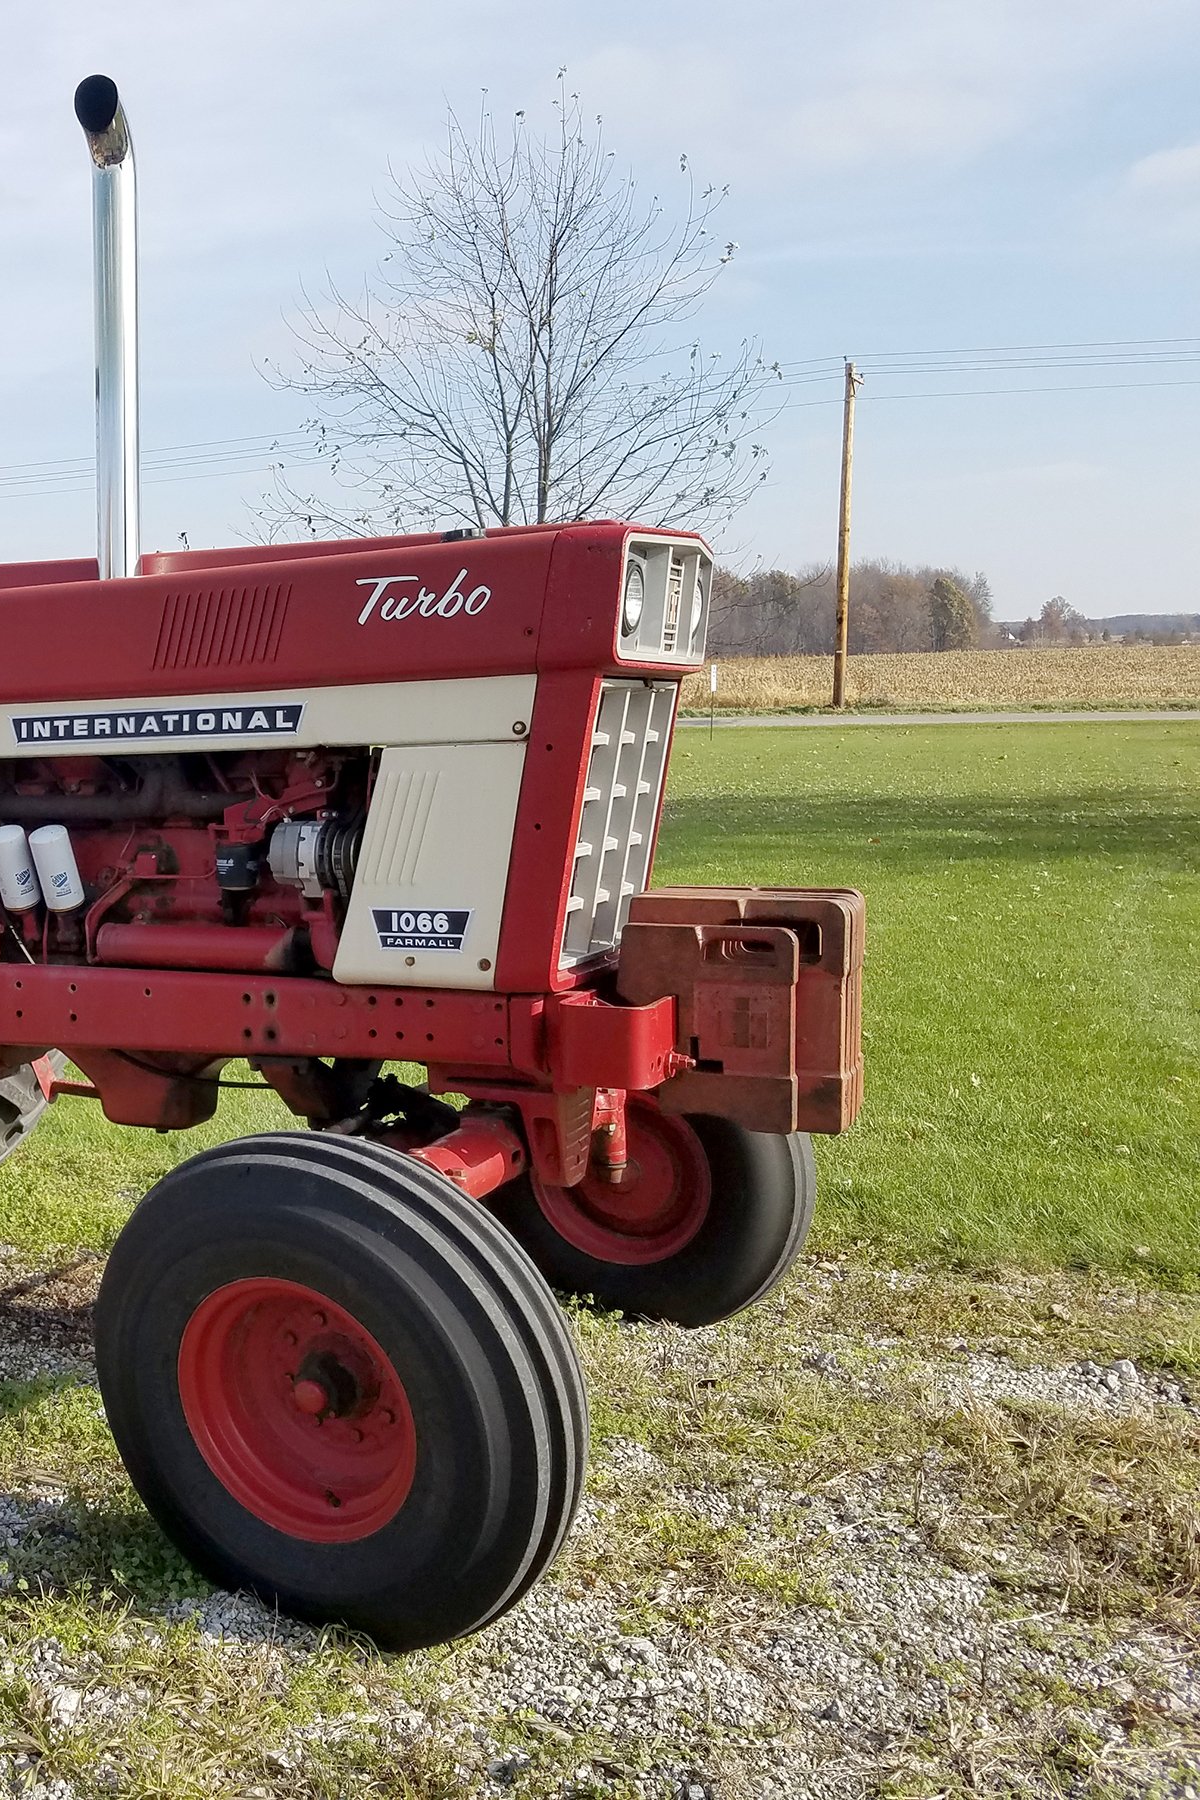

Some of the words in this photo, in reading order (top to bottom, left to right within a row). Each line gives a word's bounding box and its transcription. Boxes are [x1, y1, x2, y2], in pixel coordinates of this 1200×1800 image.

[356, 568, 492, 626] Turbo
[20, 710, 294, 739] INTERNATIONAL
[391, 911, 449, 933] 1066
[387, 937, 455, 947] FARMALL
